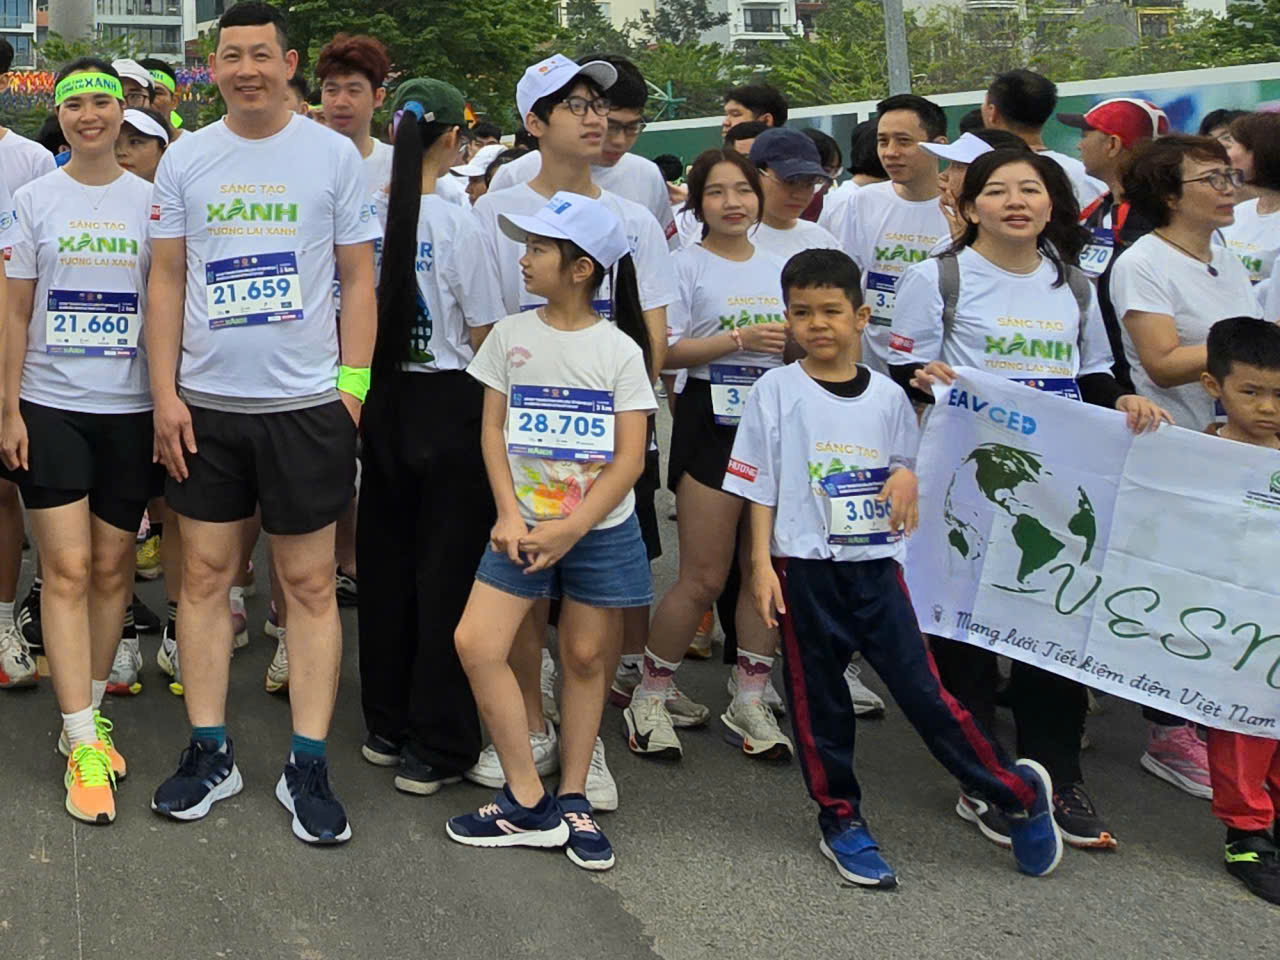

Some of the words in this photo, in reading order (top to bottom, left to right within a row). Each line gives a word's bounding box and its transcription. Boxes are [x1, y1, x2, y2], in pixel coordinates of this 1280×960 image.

[85, 77, 117, 92] XANH
[220, 183, 256, 194] SÁNG
[259, 183, 286, 196] TẠO
[207, 198, 298, 222] XANH
[58, 233, 138, 255] XANH
[874, 244, 928, 263] XAN
[213, 278, 291, 305] 21.659
[53, 314, 128, 334] 21.660
[984, 333, 1073, 362] XANH
[519, 412, 606, 437] 28.705
[956, 610, 1000, 642] Mạng
[1001, 628, 1038, 653] lưới
[1041, 640, 1078, 668] Tiết
[1078, 656, 1125, 686] kiệm
[1130, 673, 1171, 702] điện
[1178, 687, 1222, 719] Việt
[1227, 703, 1278, 729] Nam
